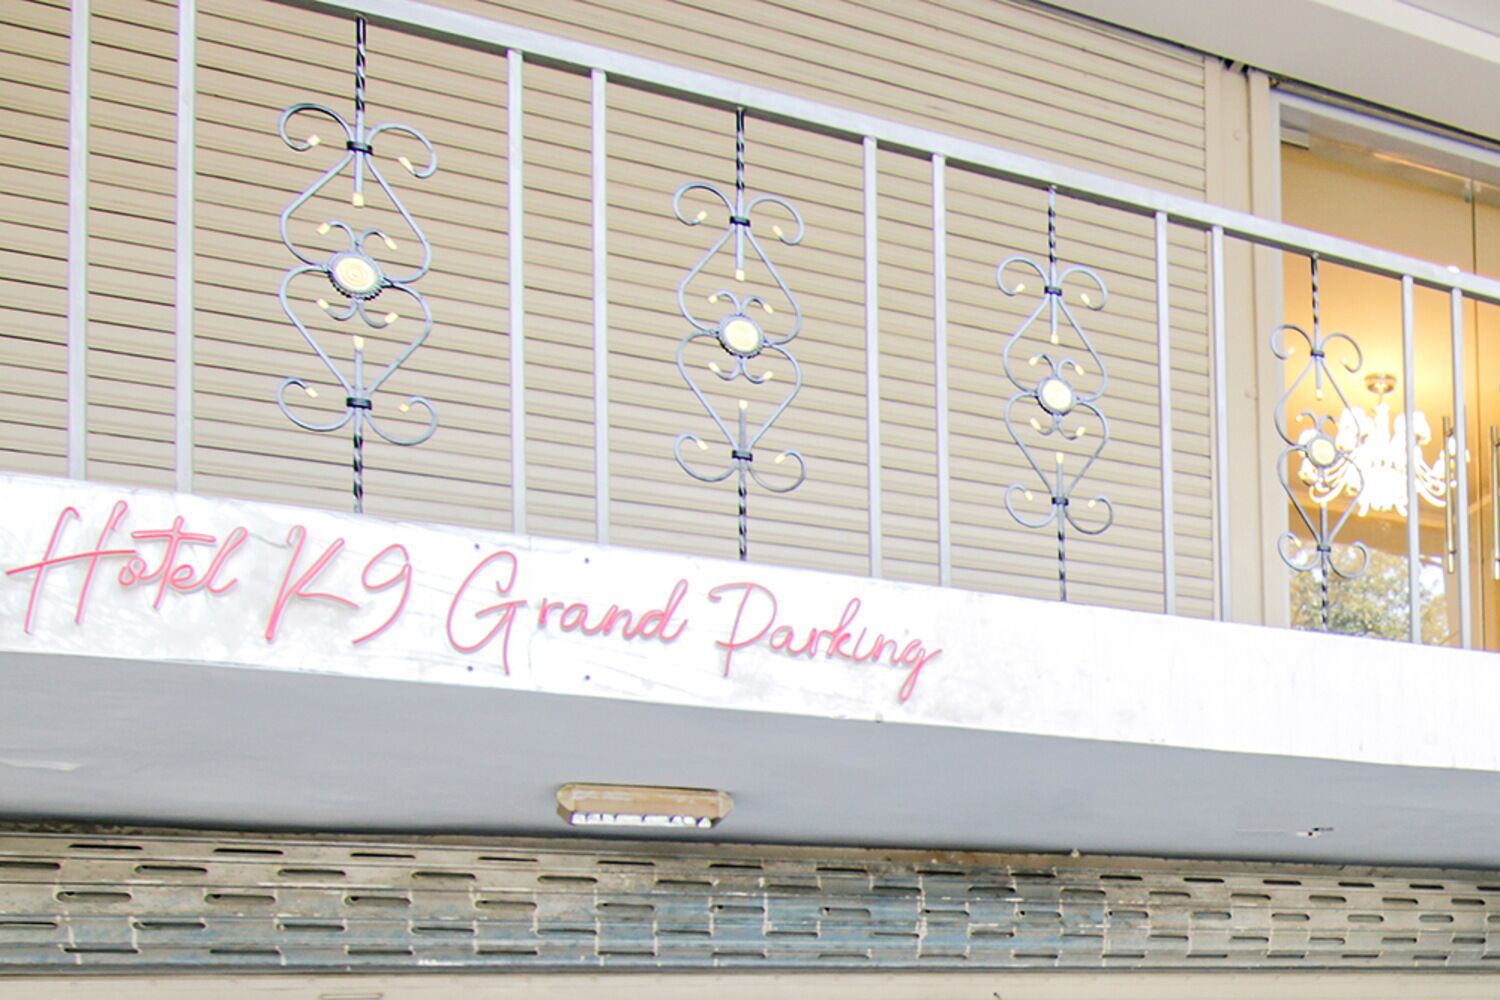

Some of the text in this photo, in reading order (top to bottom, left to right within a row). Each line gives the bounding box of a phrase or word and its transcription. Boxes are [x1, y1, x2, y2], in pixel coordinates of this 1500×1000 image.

[6, 500, 943, 701] Hotel K9 Grand Parking
